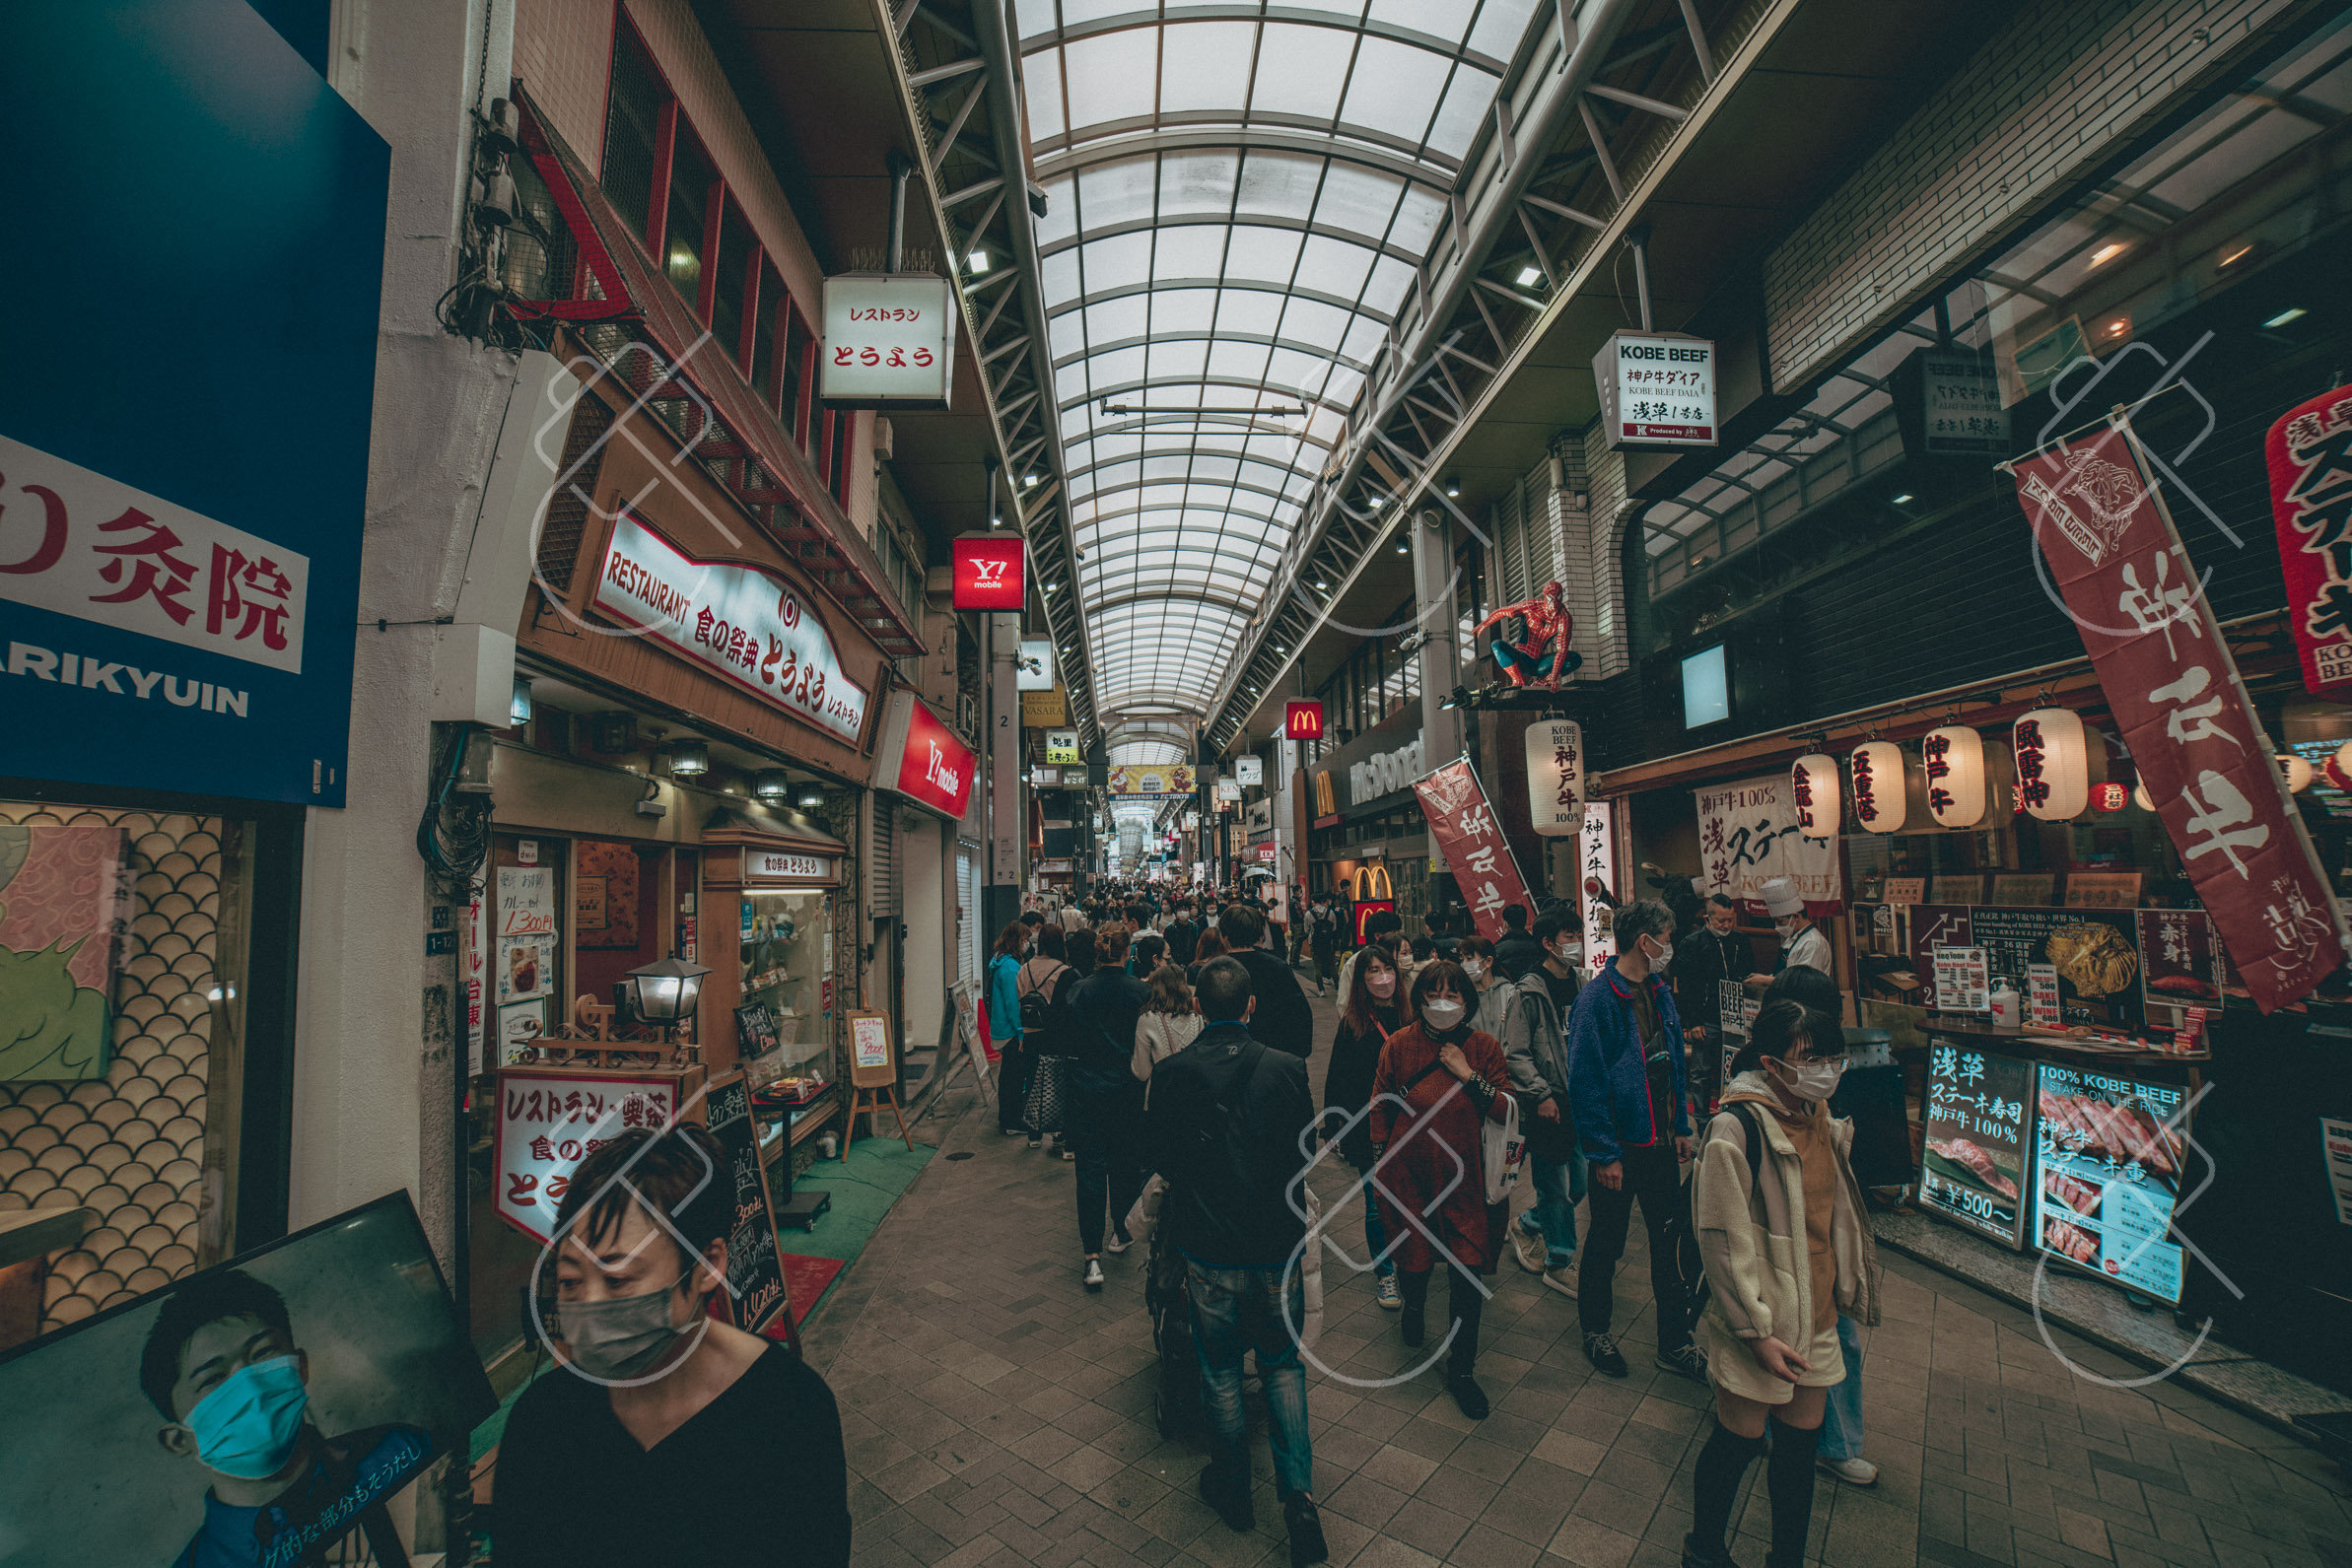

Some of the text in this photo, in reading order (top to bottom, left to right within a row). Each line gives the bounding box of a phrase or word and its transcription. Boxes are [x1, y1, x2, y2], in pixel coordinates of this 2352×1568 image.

[850, 307, 920, 322] レストラン
[834, 346, 934, 368] とうよう
[1621, 345, 1708, 364] KOBE BEEF
[1626, 369, 1700, 386] 神戸牛ダイア
[1628, 386, 1653, 395] KOBE
[1678, 389, 1699, 398] DAIA
[1632, 400, 1703, 422] 浅草1号店
[969, 558, 1005, 579] Y!
[606, 550, 691, 626] RESTAURANT
[974, 580, 1003, 589] mobile
[693, 604, 861, 729] 食の祭典 とうよう レストラン
[0, 641, 248, 717] RIKYUIN
[1001, 716, 1008, 727] 2
[1025, 706, 1064, 716] VASARA
[1552, 725, 1577, 735] KOBE
[1553, 735, 1577, 745] BEEF
[2016, 719, 2050, 809] 風雷神
[1555, 745, 1579, 812] 神戸牛
[1852, 749, 1879, 822] 五重塔
[1925, 734, 1955, 817] 神戸牛
[1701, 785, 1776, 815] 神戸牛100%
[1792, 762, 1814, 829] 金龍山
[1555, 813, 1581, 823] 100%
[1260, 850, 1275, 858] KEN
[1701, 817, 1730, 893] 浅草
[1790, 873, 1835, 894] BEEF
[431, 936, 452, 949] 1-12
[2159, 922, 2181, 963] 赤身
[1720, 981, 1743, 997] KOBE
[2033, 991, 2056, 1000] SAKE
[2033, 1007, 2058, 1016] WINE
[1932, 1046, 1985, 1087] 浅草
[2040, 1064, 2181, 1105] 100% KOBE BEEF
[1931, 1082, 2023, 1125] ステーキ寿司
[2050, 1081, 2169, 1117] STAKE ON THE RICE
[2039, 1115, 2093, 1145] 神戸牛
[2041, 1139, 2148, 1188] ステーキ重
